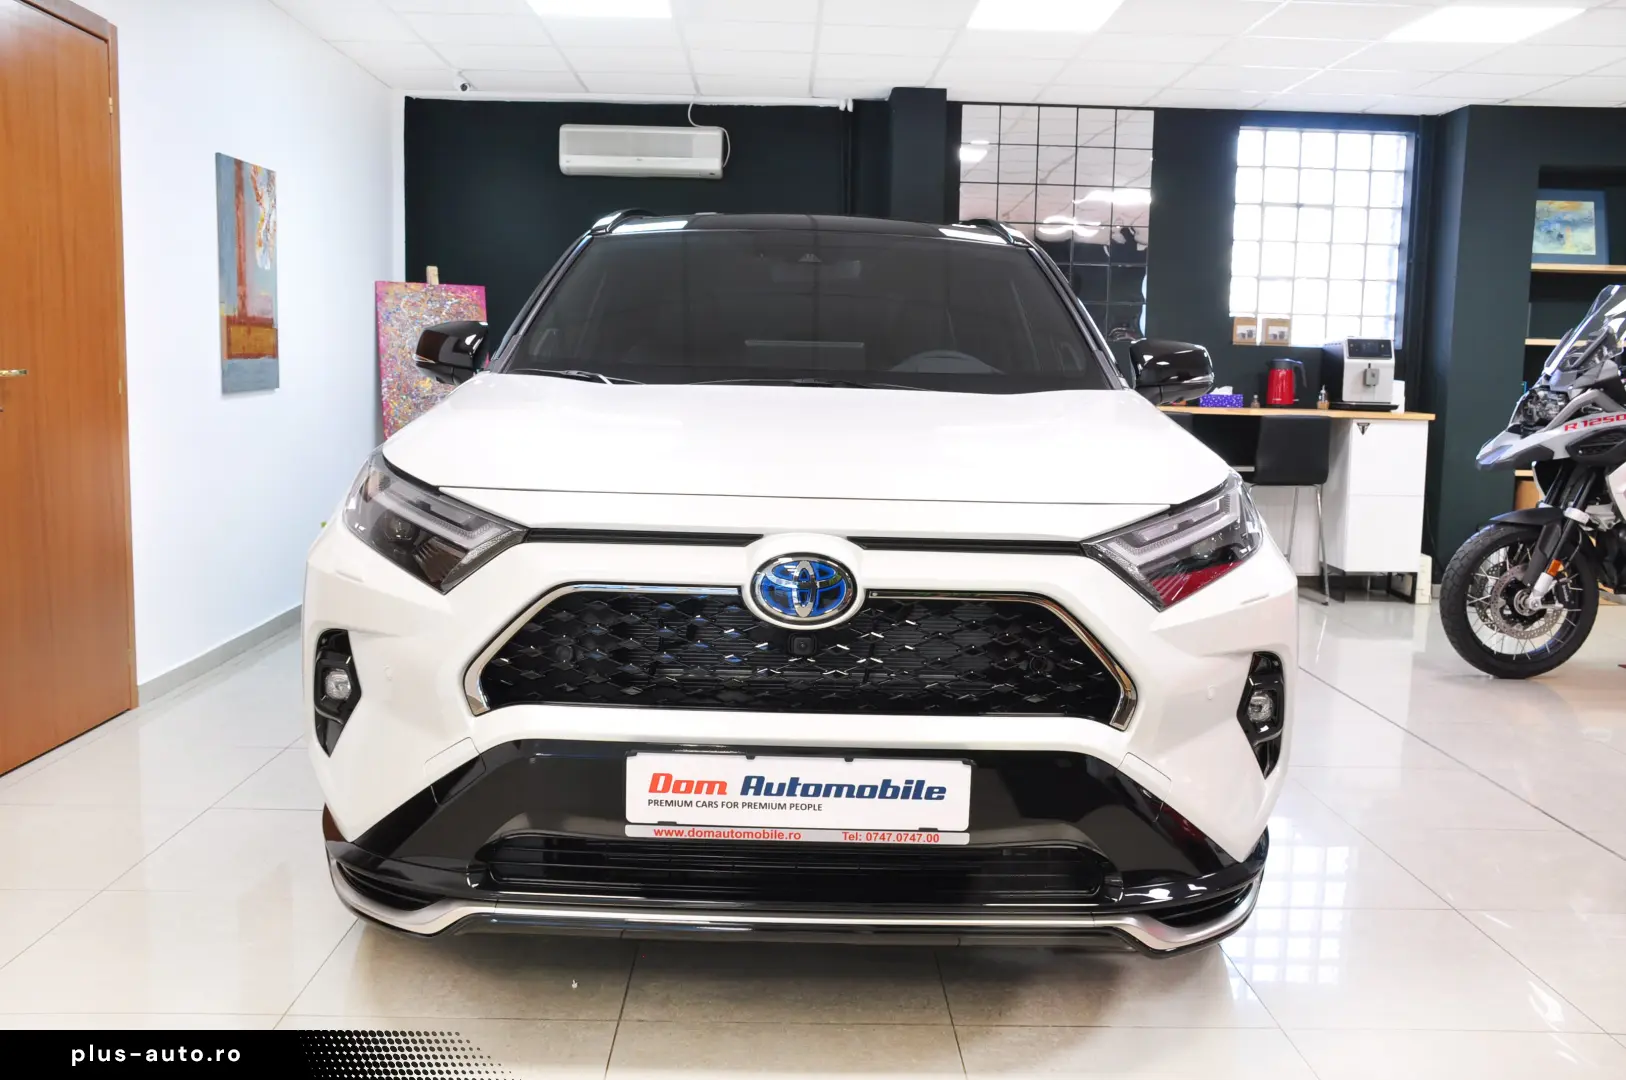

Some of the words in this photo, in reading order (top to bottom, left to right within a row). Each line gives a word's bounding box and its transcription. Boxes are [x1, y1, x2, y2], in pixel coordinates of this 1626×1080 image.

[1564, 422, 1578, 431] R
[1581, 413, 1626, 427] 1250
[648, 772, 728, 796] Dom
[740, 775, 947, 801] Automobile
[647, 799, 693, 808] PREMIUM
[695, 800, 719, 809] CARS
[721, 801, 739, 809] FOR
[741, 801, 787, 810] PREMIUM
[789, 803, 823, 811] PEOPLE
[653, 828, 802, 840] www.domautomobile.ro
[842, 831, 862, 841] Tel:
[865, 832, 940, 843] 0747.0747.00
